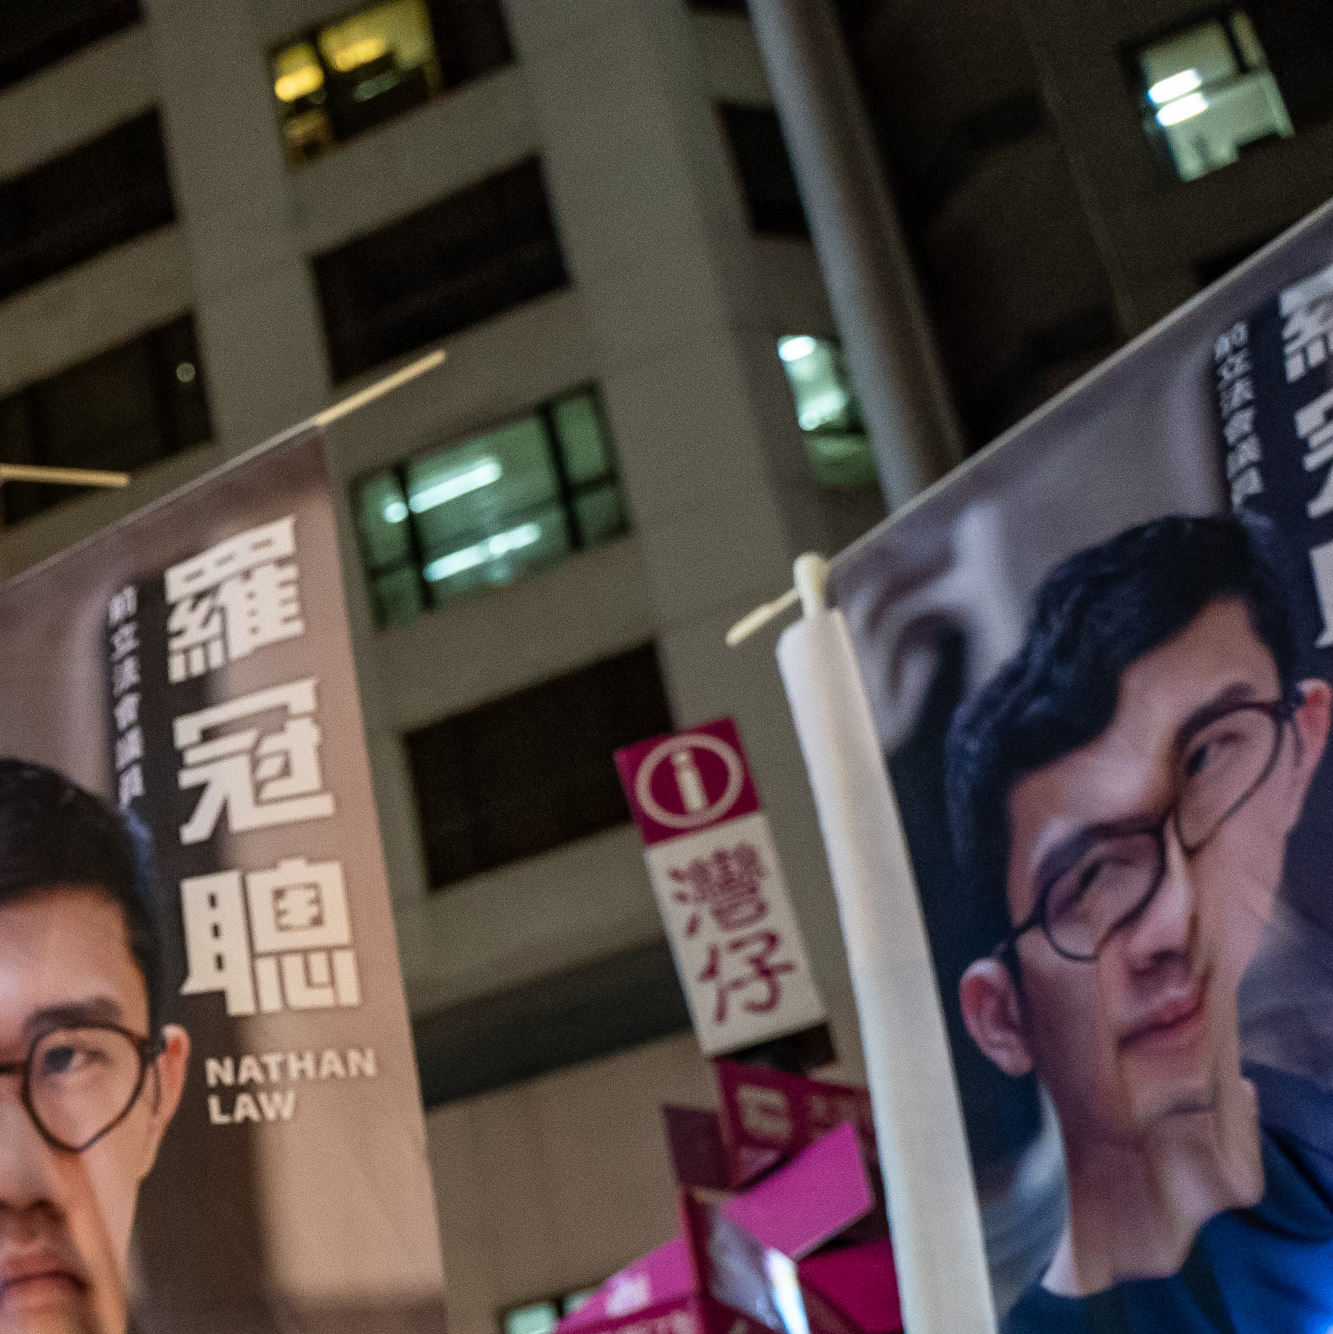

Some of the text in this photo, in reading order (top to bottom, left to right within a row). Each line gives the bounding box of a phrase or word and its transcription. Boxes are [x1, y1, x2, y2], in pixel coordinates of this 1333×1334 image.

[164, 515, 361, 1016] 羅冠聰
[671, 843, 795, 1024] 灣仔
[205, 1047, 378, 1087] NATHAN
[207, 1088, 296, 1125] LAW
